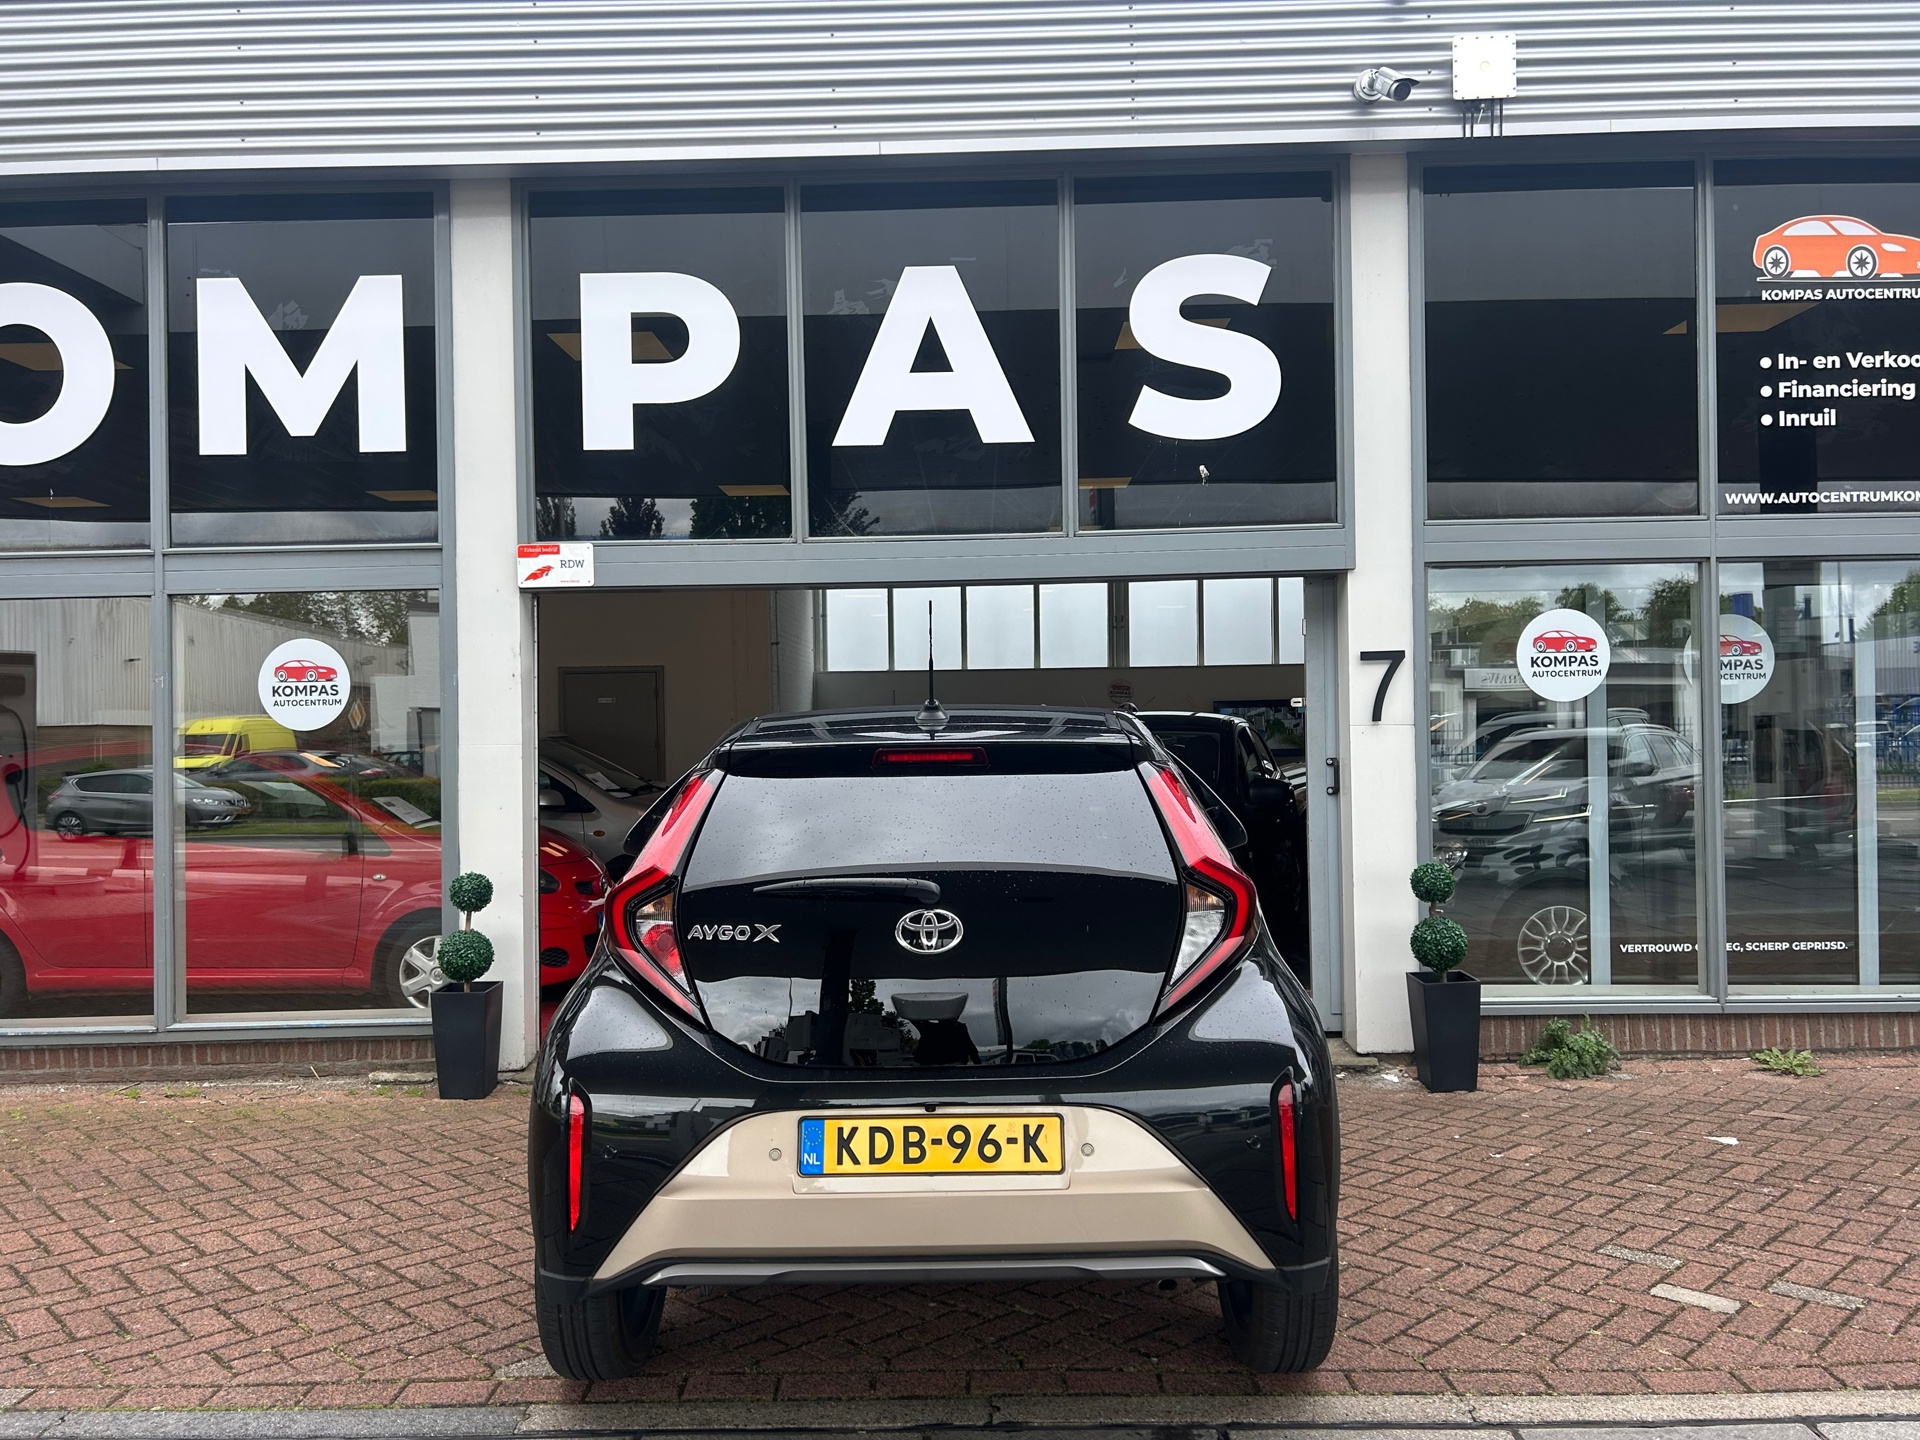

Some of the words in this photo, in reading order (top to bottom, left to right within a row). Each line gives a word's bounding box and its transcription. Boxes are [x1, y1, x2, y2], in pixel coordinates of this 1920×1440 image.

[1761, 289, 1823, 301] KOMPAS
[1777, 353, 1808, 370] In-
[1812, 355, 1841, 369] en
[1845, 351, 1920, 369] Verkoo
[1778, 378, 1916, 401] Financiering
[1778, 407, 1837, 427] Inruil
[560, 559, 585, 569] RDW
[1530, 654, 1599, 668] KOMPAS
[1720, 658, 1764, 671] MPAS
[1531, 669, 1602, 678] AUTOCENTRUM
[1720, 672, 1767, 680] CENTRUM
[272, 684, 339, 697] KOMPAS
[1360, 649, 1406, 722] 7
[273, 698, 342, 707] AUTOCENTRUM
[1619, 943, 1693, 953] VERTROUWD
[1745, 941, 1790, 951] SCHERP
[1791, 941, 1848, 951] GEPRIJSD.
[803, 1152, 821, 1165] NL
[836, 1123, 1049, 1166] KDB-96-K
